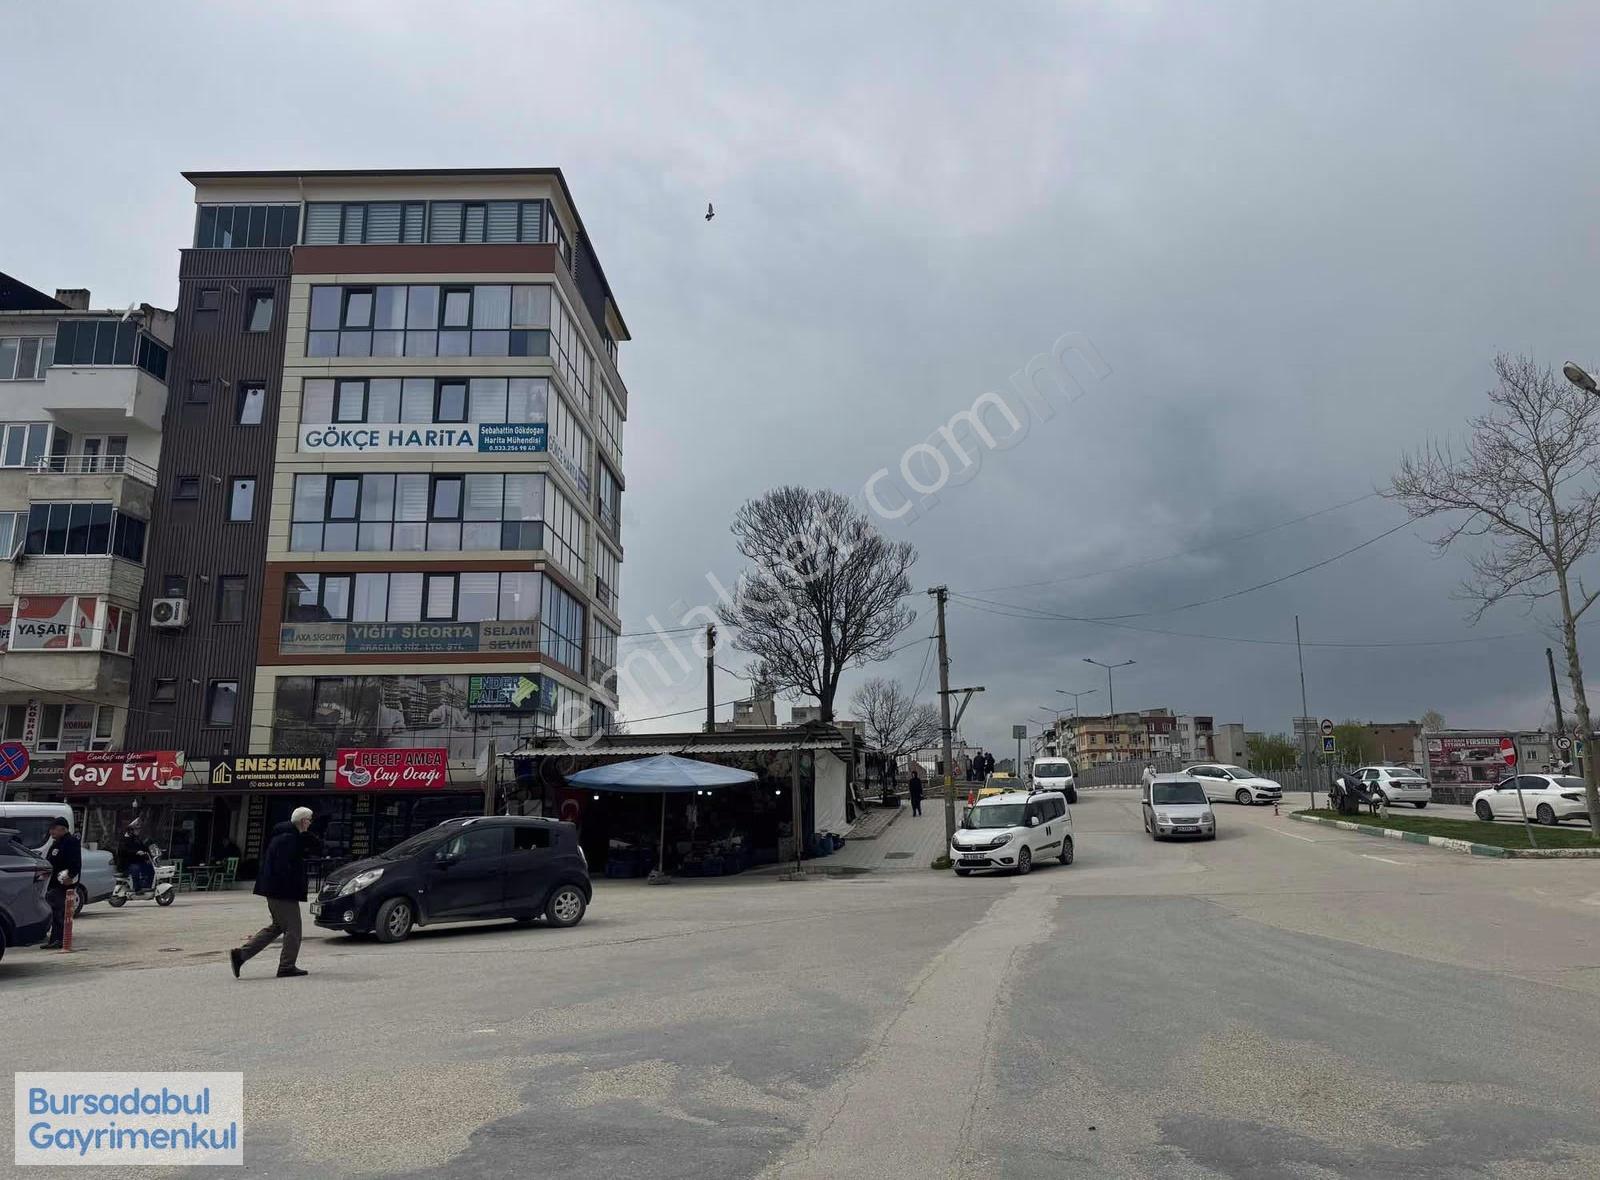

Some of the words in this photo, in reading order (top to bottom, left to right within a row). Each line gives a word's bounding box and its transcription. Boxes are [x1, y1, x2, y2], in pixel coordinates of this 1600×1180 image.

[305, 426, 381, 450] GÖKÇE
[481, 427, 514, 435] Sebahattin
[18, 624, 67, 638] YAŞAR
[352, 624, 397, 639] YİĞİT
[404, 624, 473, 638] SİGORTA
[484, 625, 534, 637] SELAMİ
[489, 638, 532, 650] SEVİM
[235, 758, 277, 772] ENES
[278, 758, 322, 771] EMLAK
[361, 752, 401, 766] RECEP
[404, 752, 441, 766] AMCA
[69, 763, 112, 786] Çay
[122, 761, 158, 782] Evi
[373, 767, 401, 787] Çay
[403, 767, 441, 786] Ocağı
